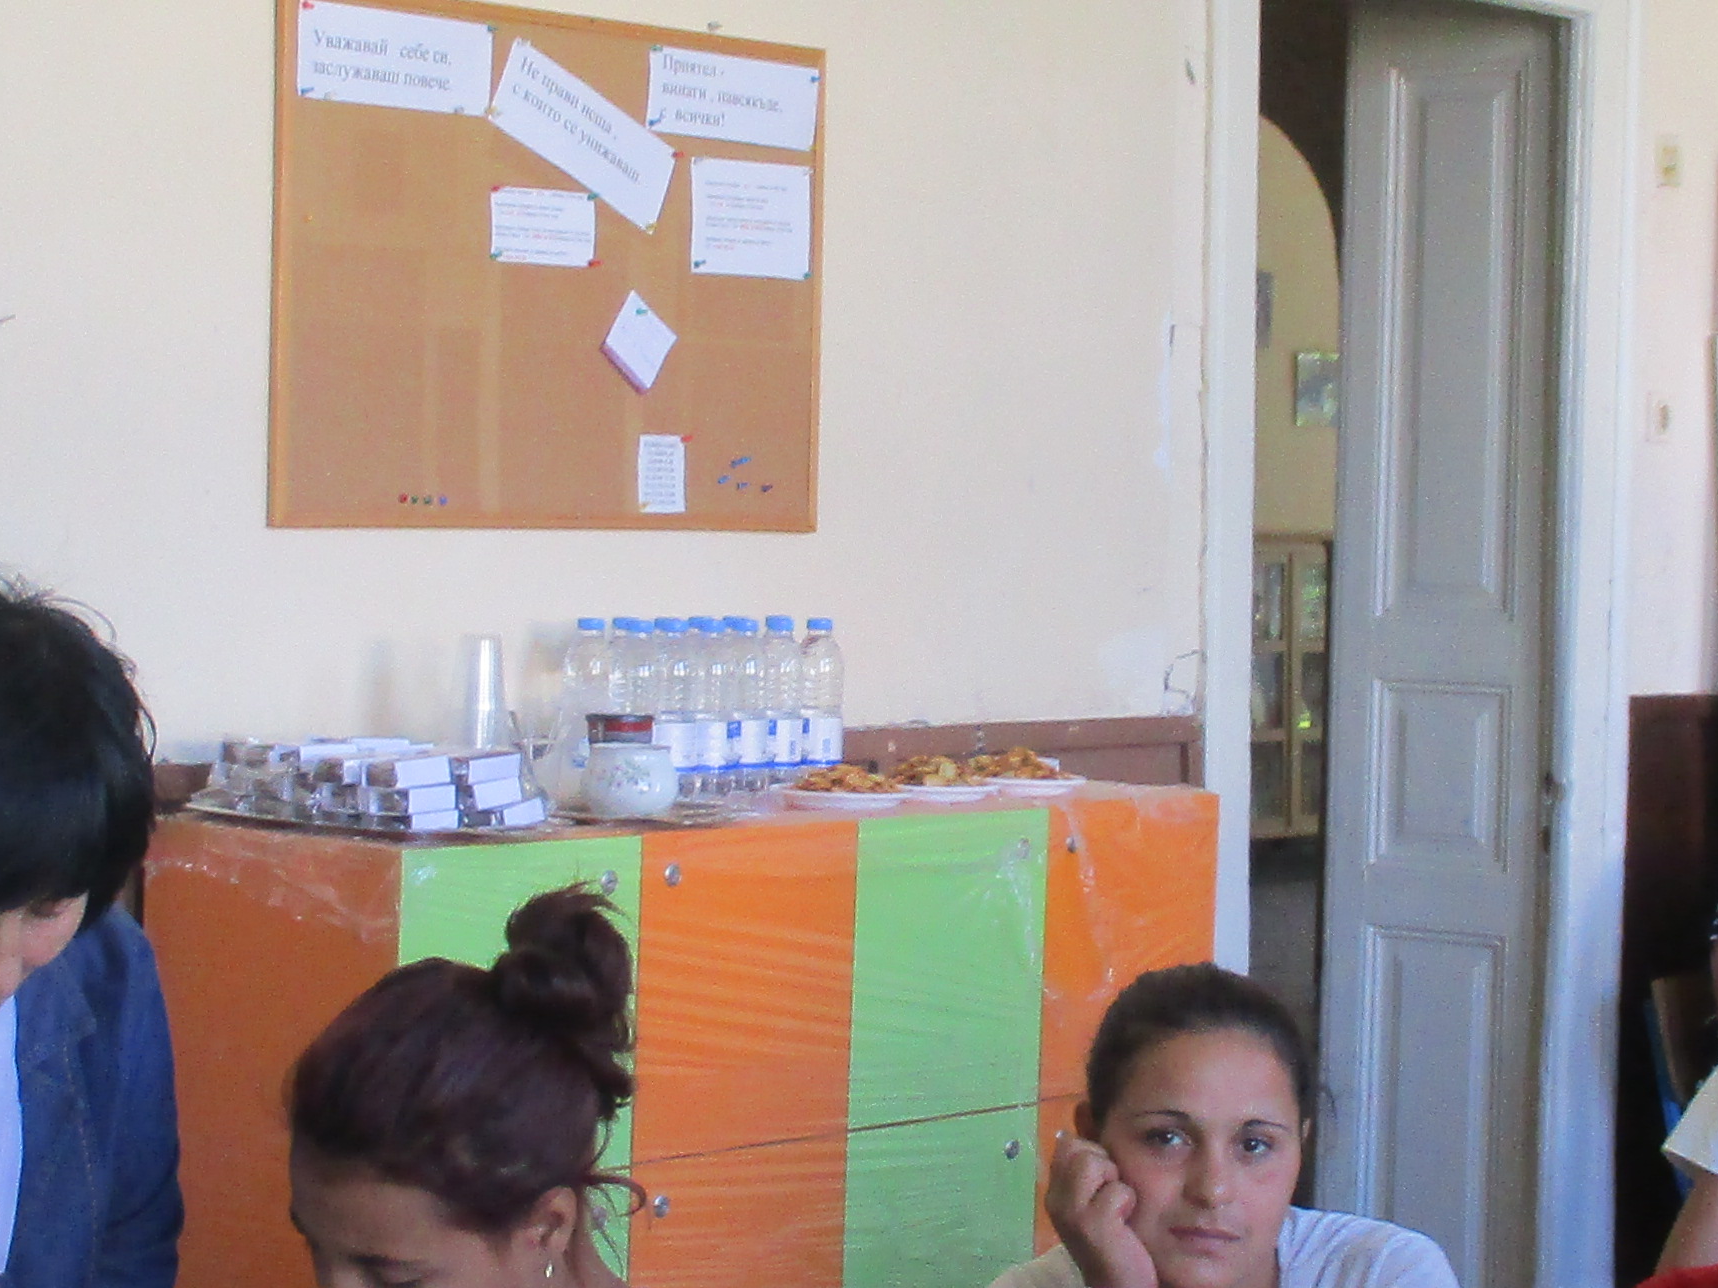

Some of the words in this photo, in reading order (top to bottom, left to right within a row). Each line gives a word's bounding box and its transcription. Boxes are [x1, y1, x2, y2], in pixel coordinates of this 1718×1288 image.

[313, 28, 389, 57] Уважавай
[399, 42, 430, 62] себе
[520, 56, 540, 81] Не
[541, 73, 580, 108] прави
[661, 82, 708, 101] винаги
[523, 89, 562, 124] които
[563, 117, 579, 135] се
[674, 108, 726, 128] всички!
